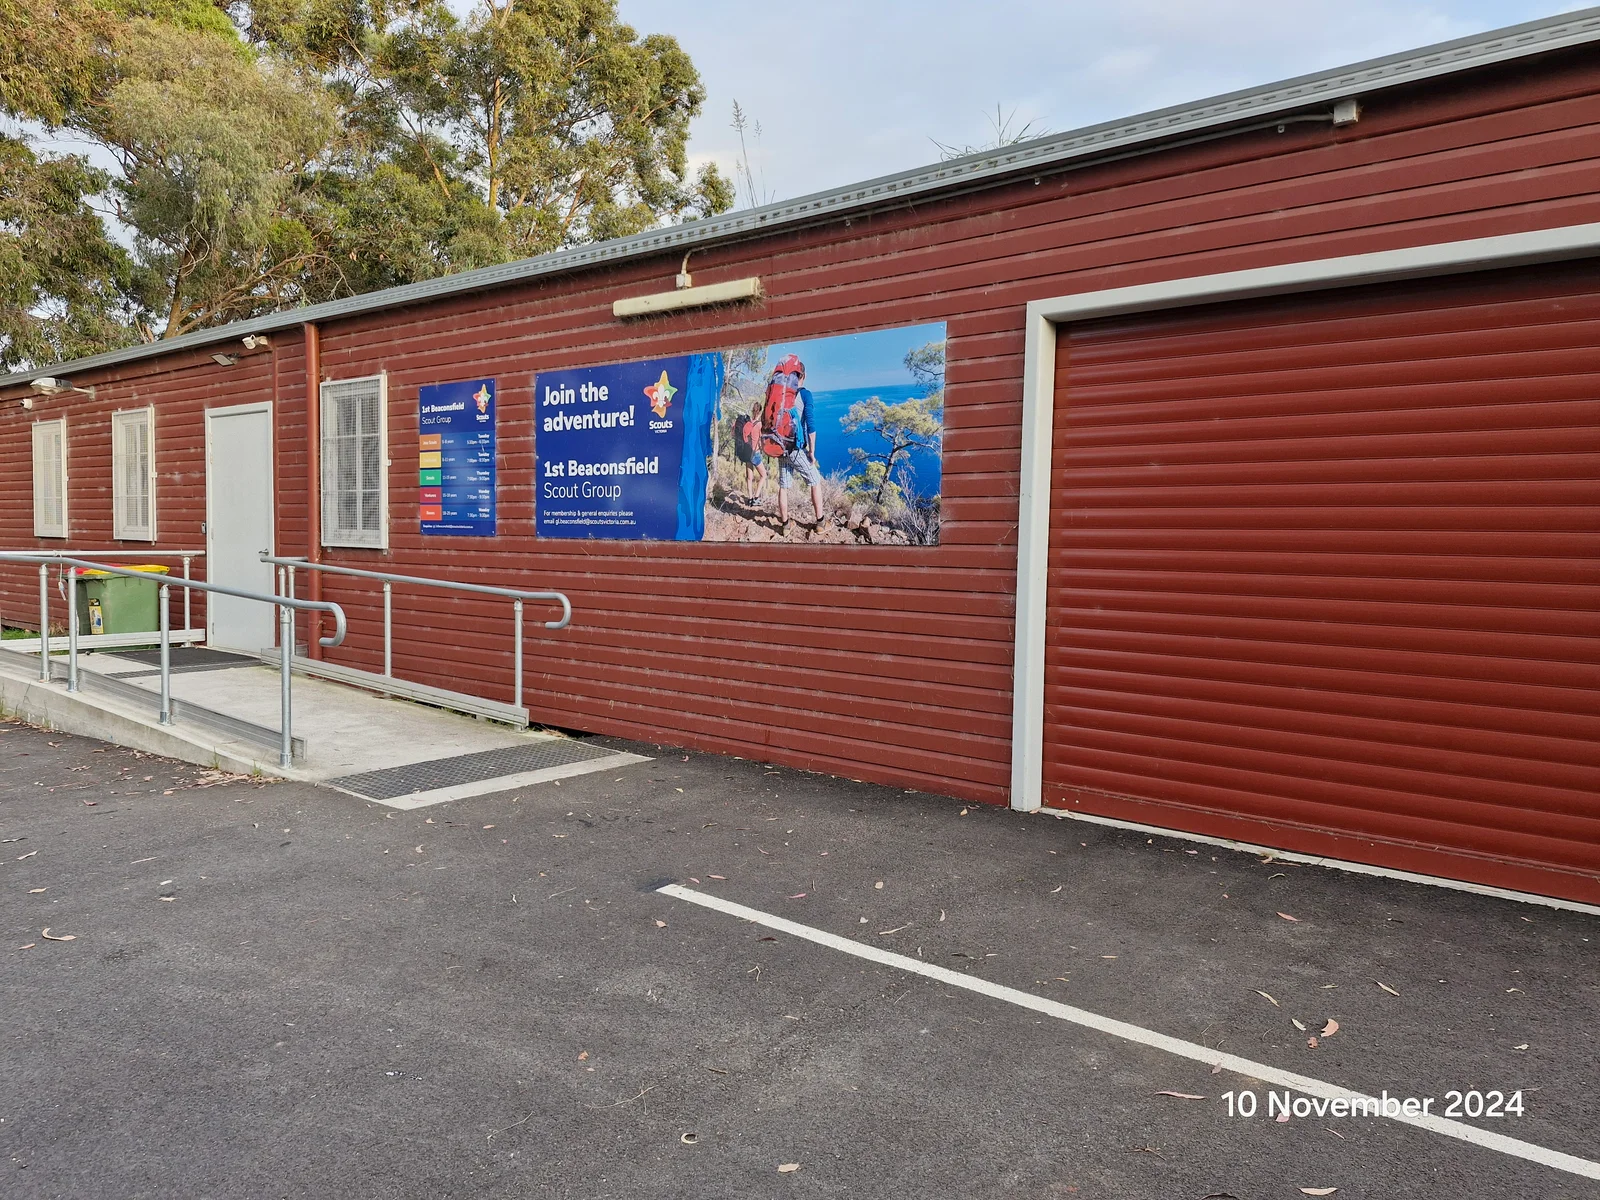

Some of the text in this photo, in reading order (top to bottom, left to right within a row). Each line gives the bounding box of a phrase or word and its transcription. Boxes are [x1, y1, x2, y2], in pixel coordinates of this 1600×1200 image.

[543, 382, 609, 407] Join the
[422, 402, 465, 414] 1st Beaconsfield
[421, 415, 452, 425] Scout Group
[543, 405, 635, 432] adventure!
[649, 420, 673, 430] Scouts
[543, 456, 659, 477] 1st Beaconsfield
[543, 481, 621, 501] Scout Group
[581, 510, 598, 518] general
[597, 510, 618, 518] enquiries
